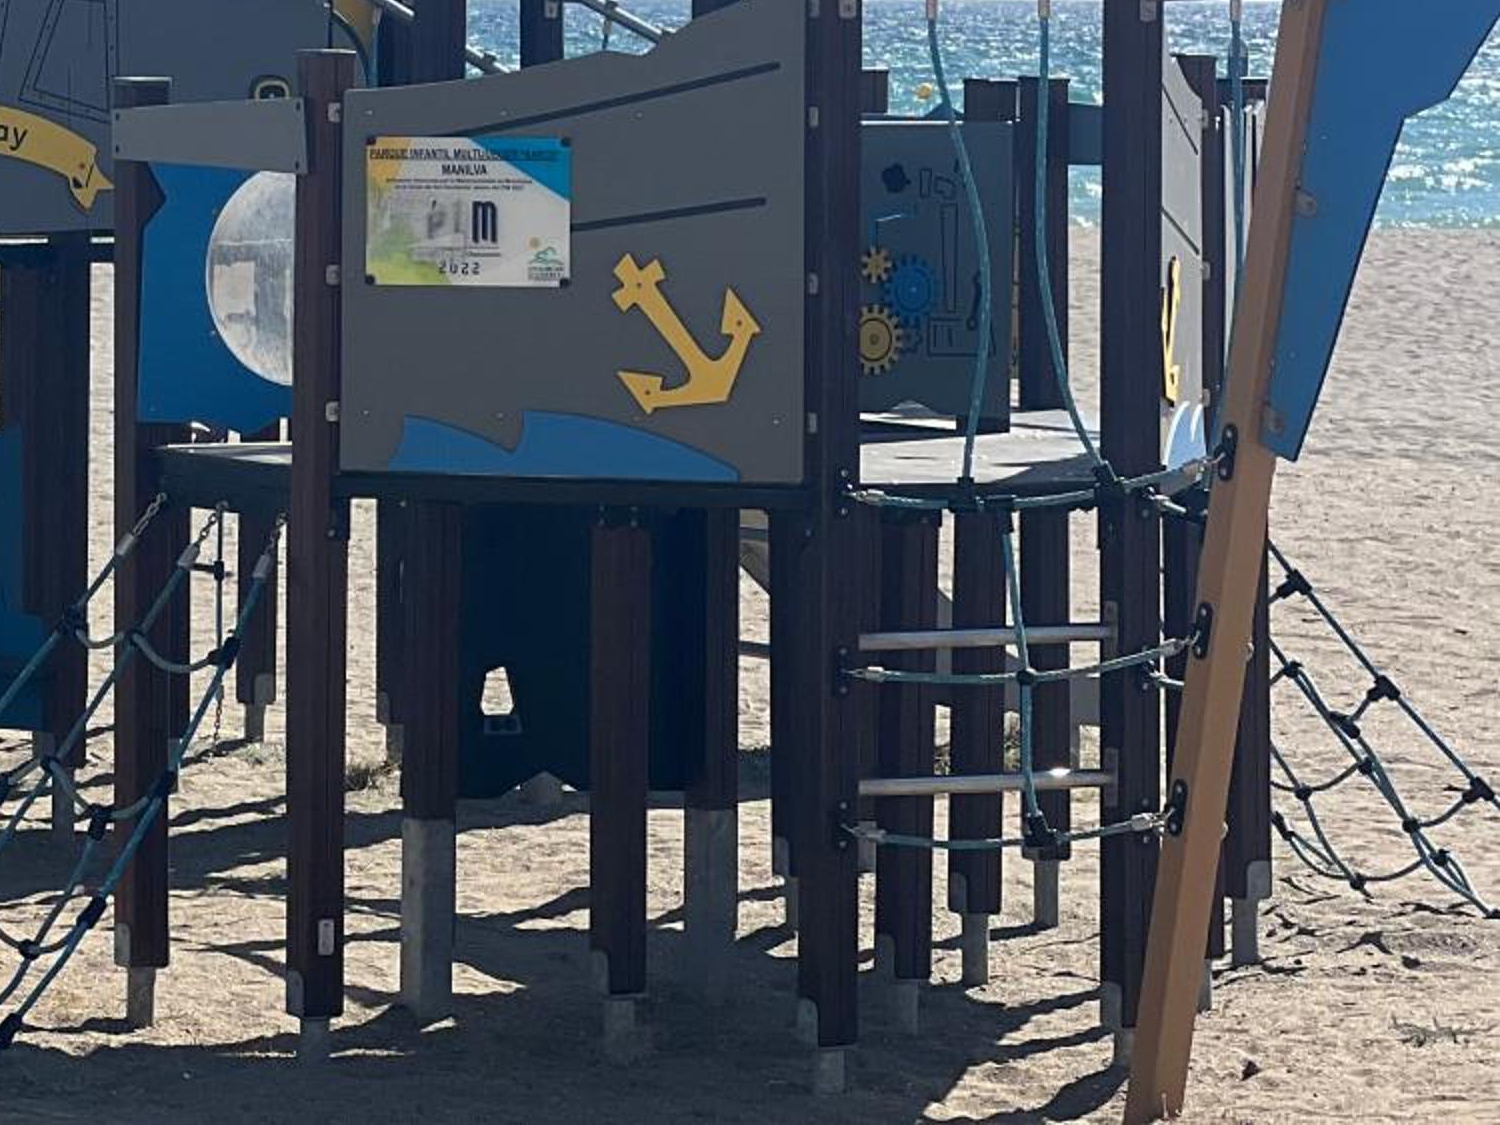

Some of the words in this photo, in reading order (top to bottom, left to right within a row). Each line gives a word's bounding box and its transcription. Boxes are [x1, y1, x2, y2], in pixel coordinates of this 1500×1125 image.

[409, 148, 452, 160] INFANTIL
[441, 163, 487, 175] MANILVA
[438, 260, 480, 275] 2022
